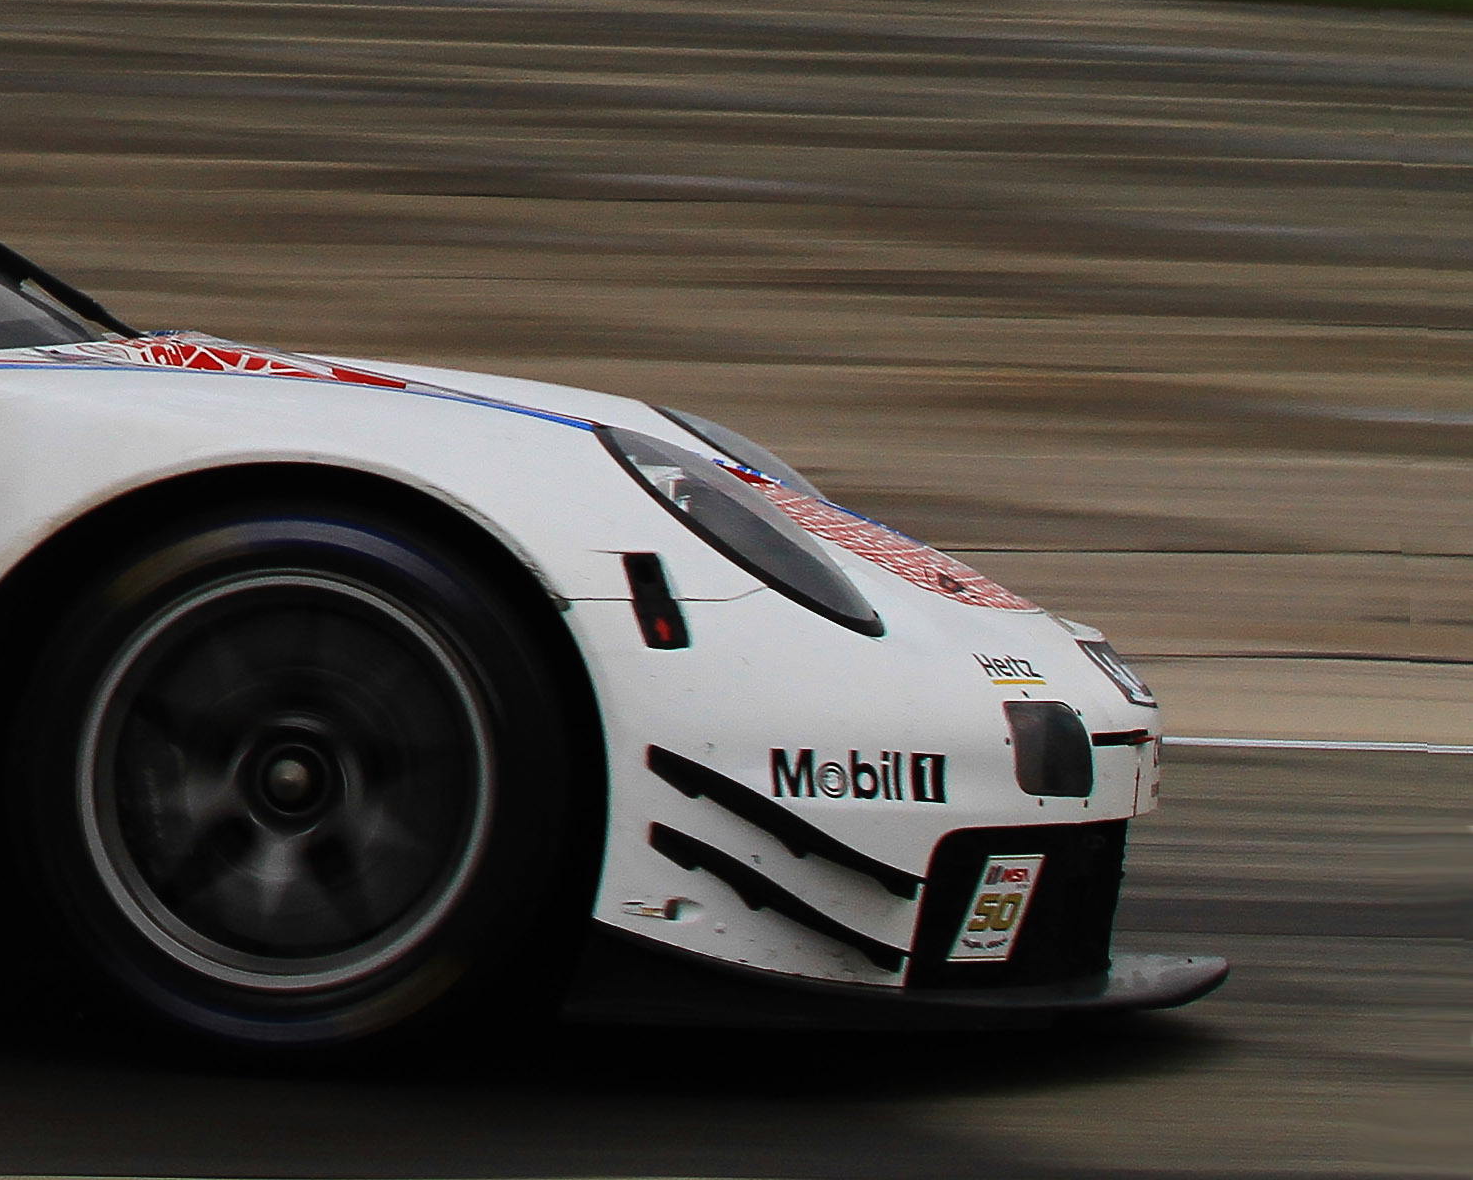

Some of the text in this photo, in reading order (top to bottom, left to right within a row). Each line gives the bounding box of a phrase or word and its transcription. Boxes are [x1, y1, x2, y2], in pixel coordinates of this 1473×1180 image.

[971, 652, 1045, 679] Hertz
[769, 748, 947, 804] Mobil 1
[967, 892, 1023, 931] 50
